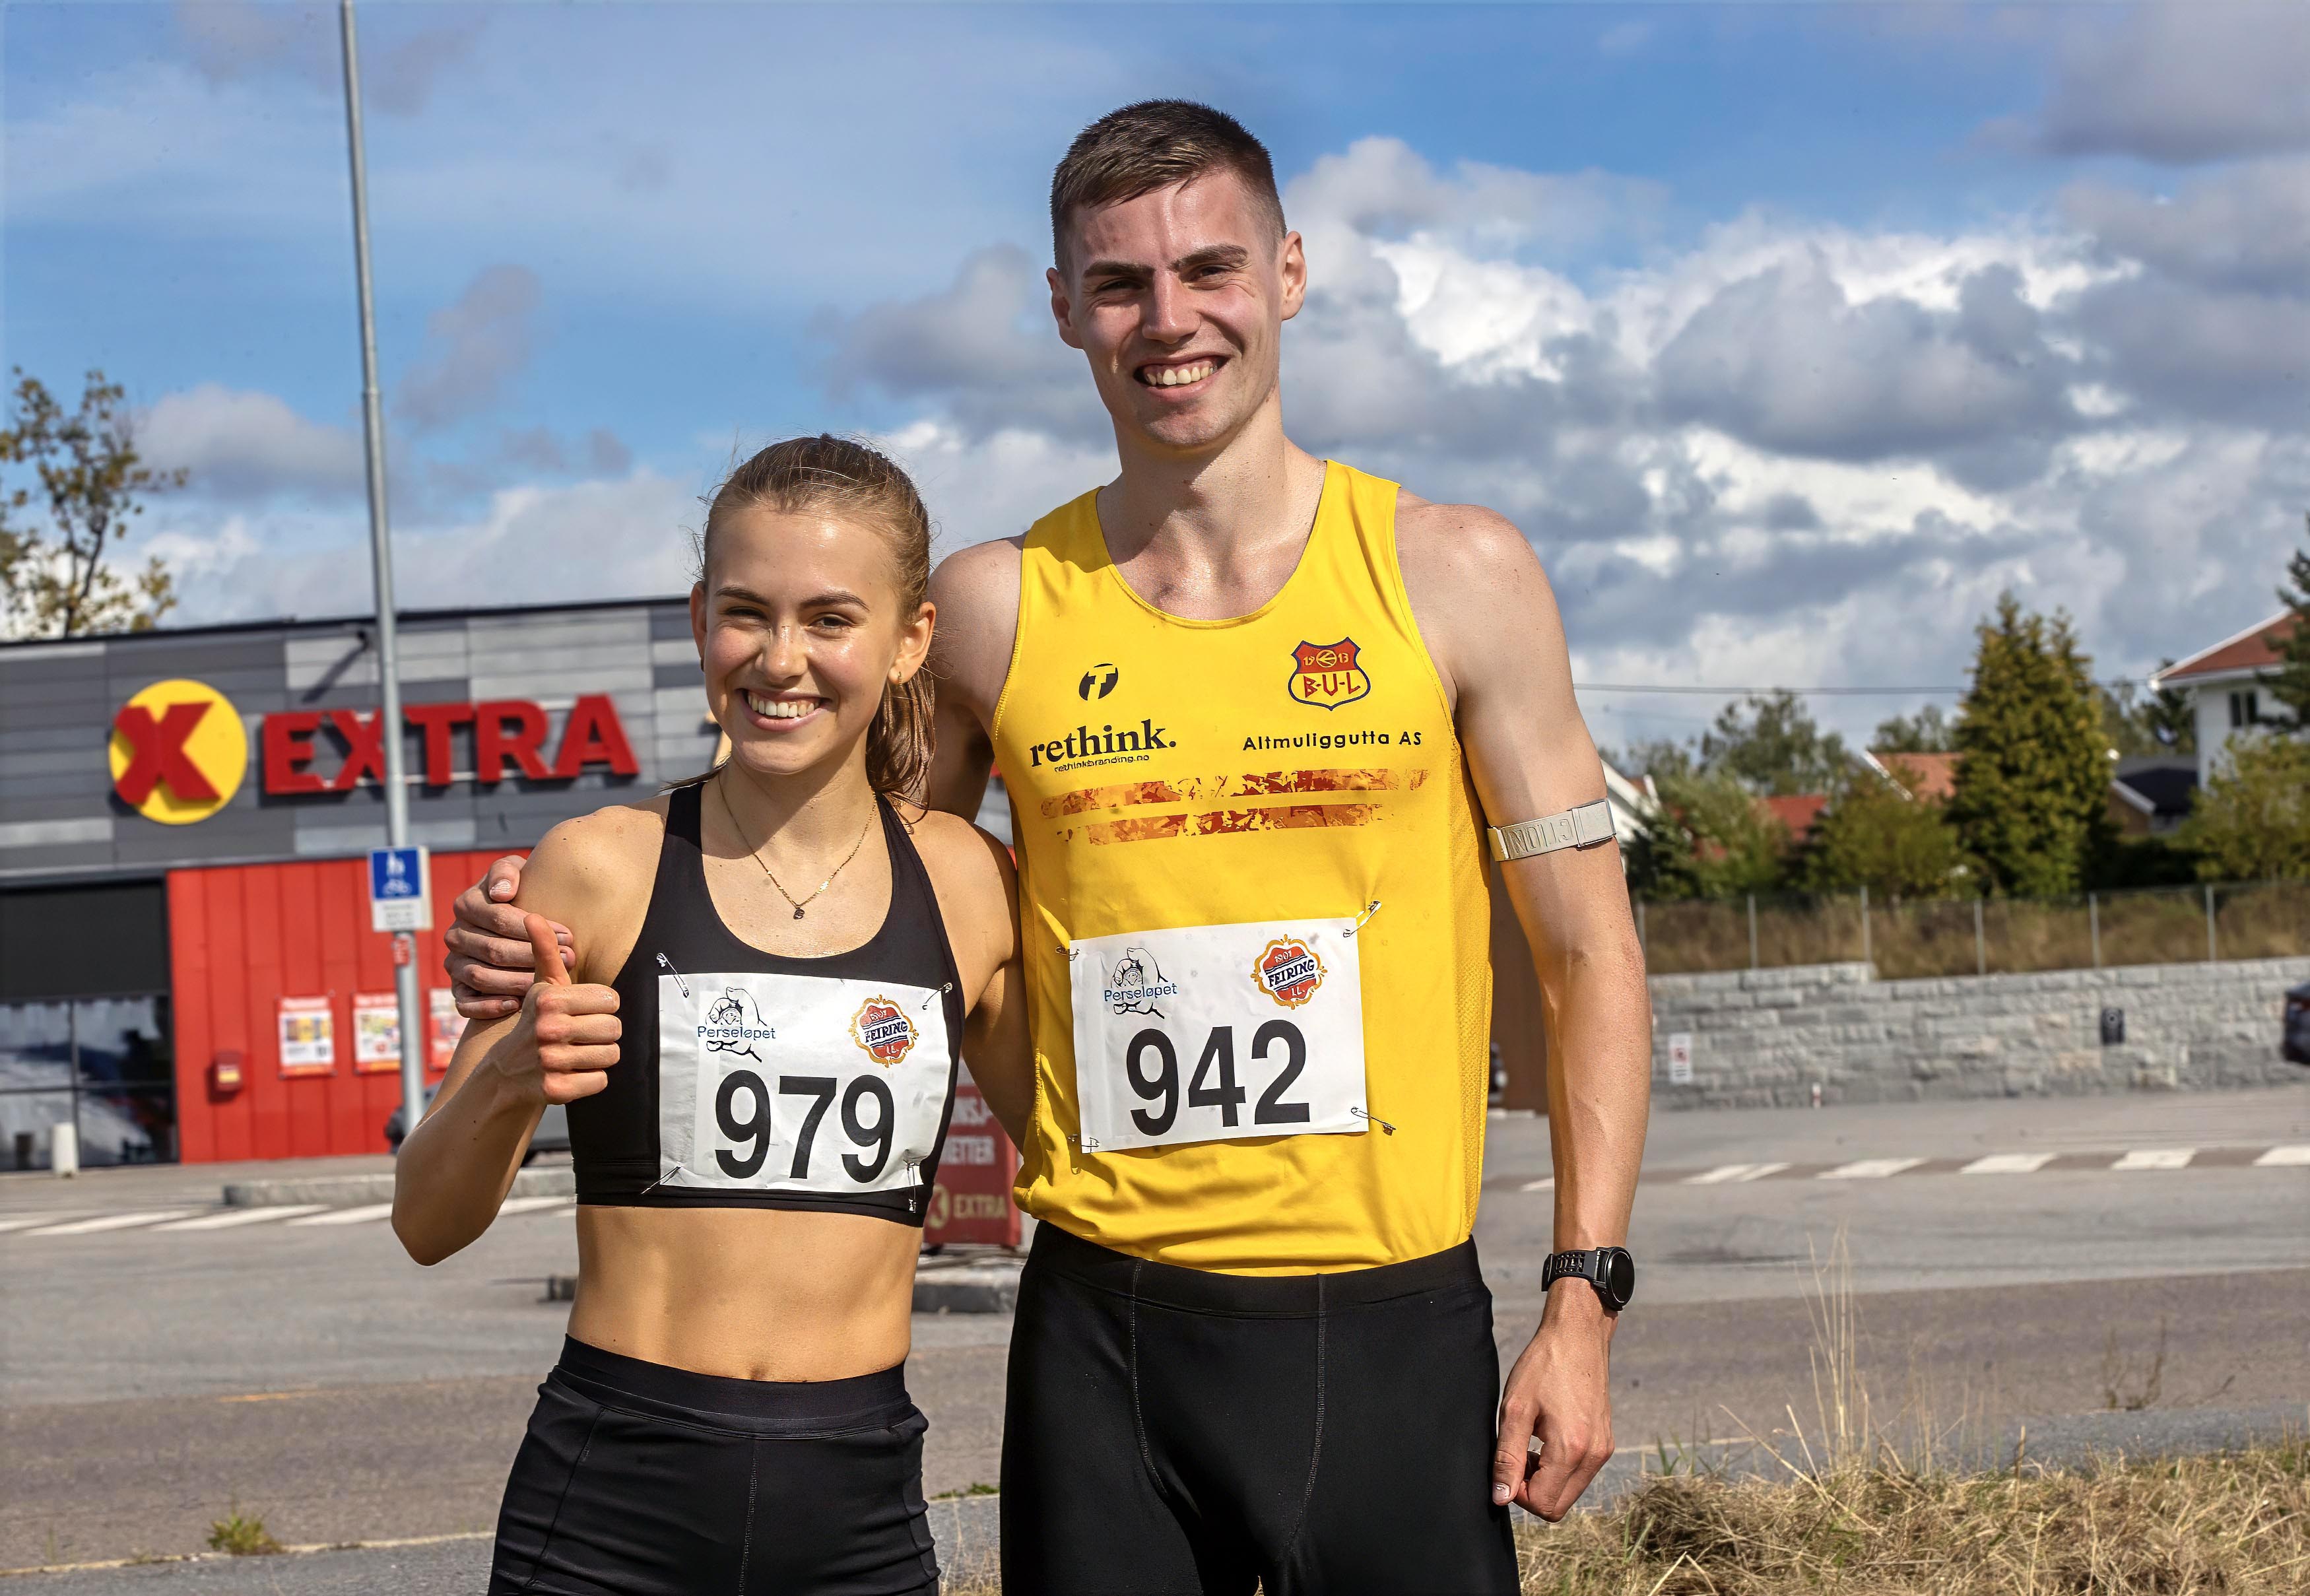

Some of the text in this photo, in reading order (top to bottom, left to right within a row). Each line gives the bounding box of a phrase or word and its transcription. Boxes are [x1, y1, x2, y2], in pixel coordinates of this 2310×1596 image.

[263, 693, 639, 794] EXTRA
[1030, 719, 1177, 767] rethink.
[1243, 731, 1422, 751] Altmuliggutta AS
[1054, 754, 1150, 772] rethinkbranding.no
[1268, 959, 1315, 987] FEIRING
[1104, 983, 1177, 1002] Perseløpet
[698, 1026, 776, 1041] Perseløpet
[864, 1021, 908, 1043] FEIRING
[1126, 1020, 1310, 1137] 942
[715, 1069, 894, 1183] 979
[953, 1193, 1008, 1218] EXTRA
